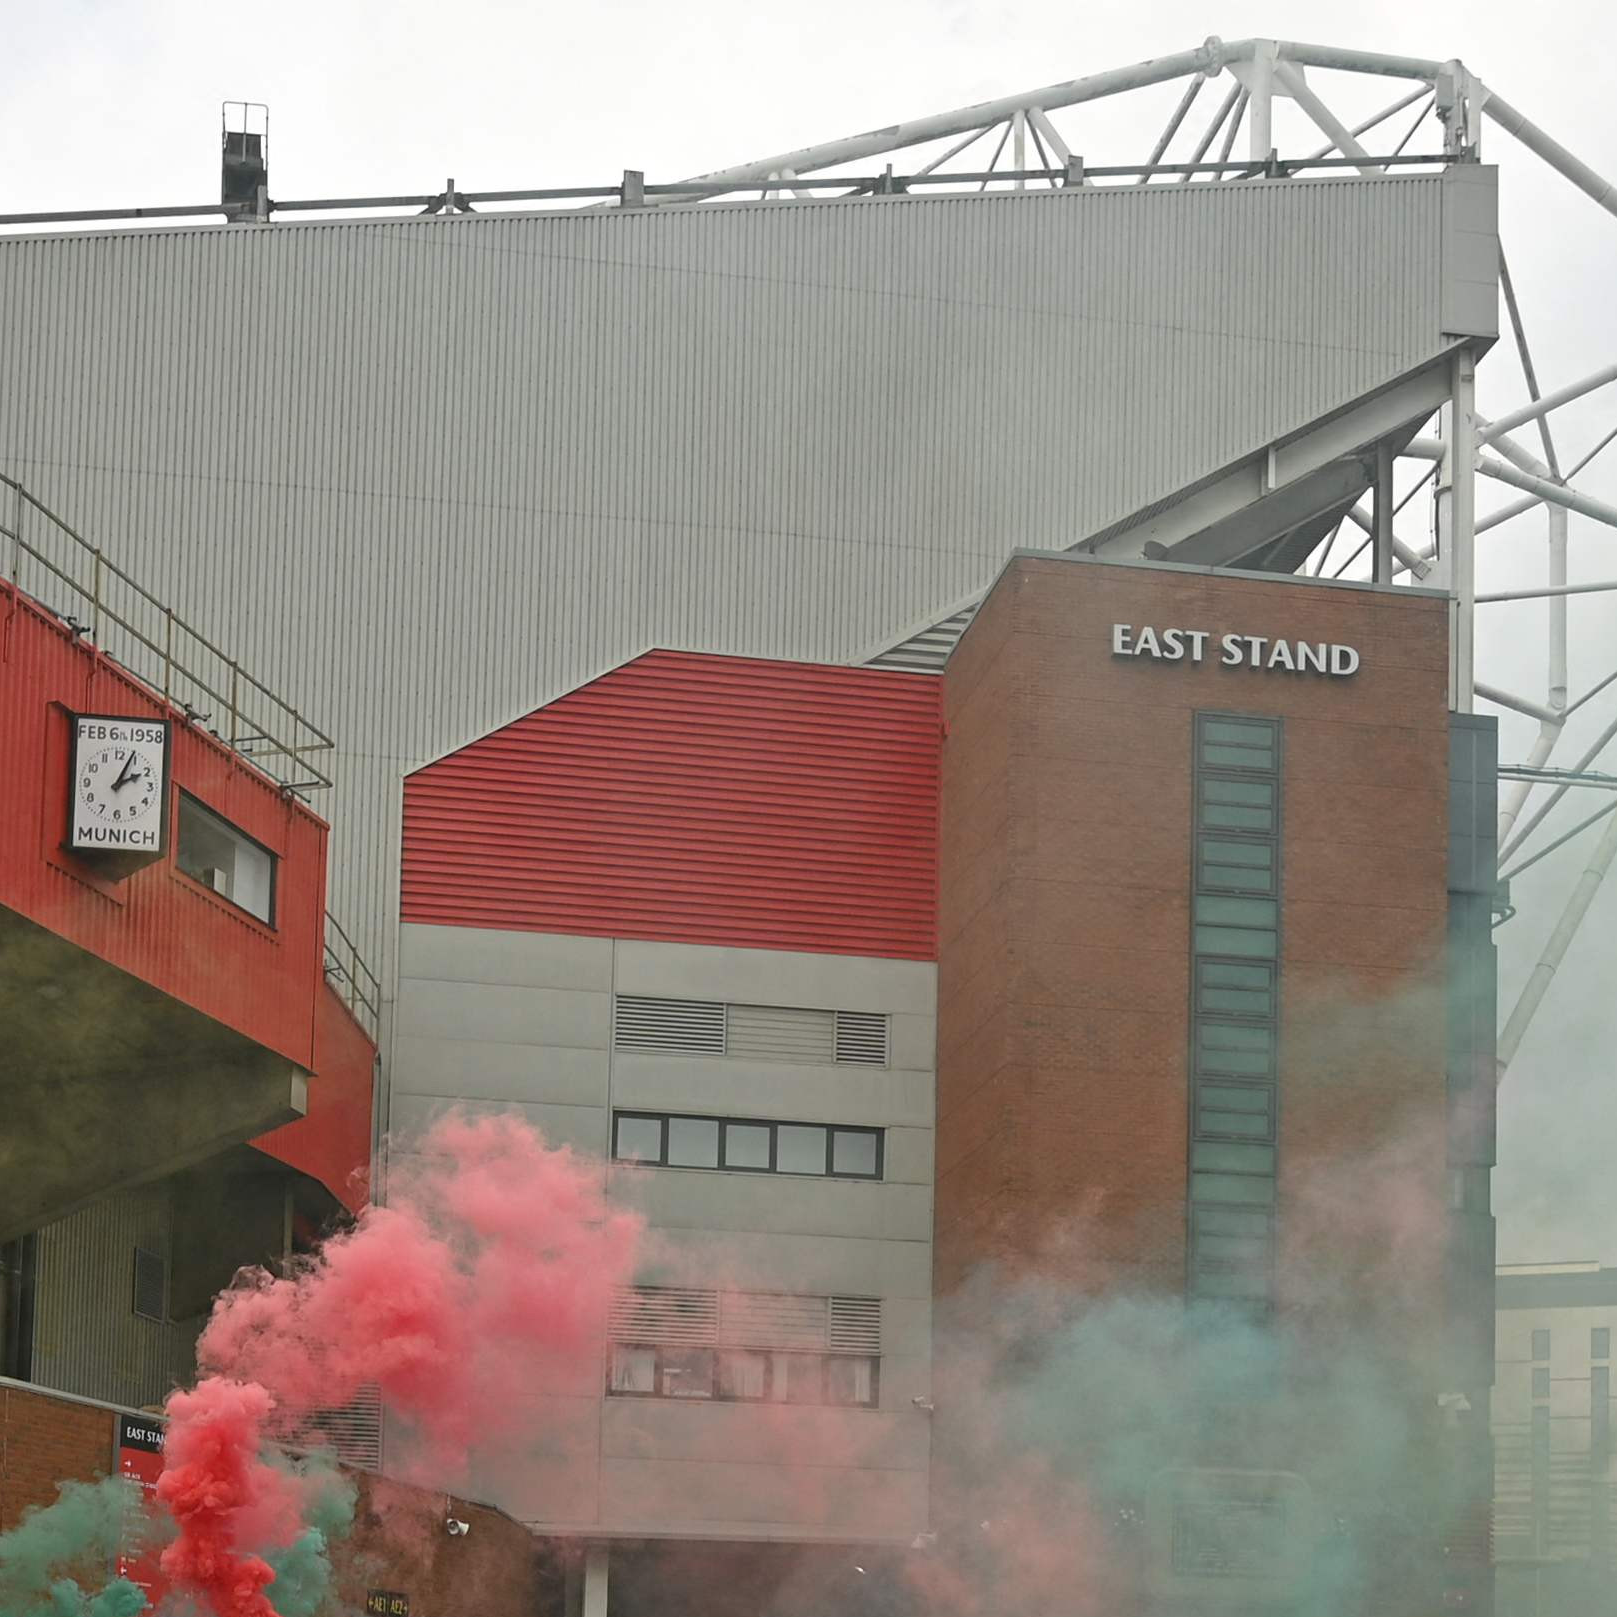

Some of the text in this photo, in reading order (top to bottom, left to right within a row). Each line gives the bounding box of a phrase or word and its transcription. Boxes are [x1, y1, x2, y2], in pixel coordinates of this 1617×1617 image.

[1112, 623, 1360, 676] EAST STAND
[78, 724, 107, 740] FEB
[129, 727, 163, 744] 1958
[101, 753, 109, 764] 11
[114, 750, 126, 761] 12
[132, 754, 138, 766] 1
[88, 763, 99, 774] 10
[143, 767, 151, 778] 2
[83, 777, 91, 788] 9
[146, 782, 155, 793] 3
[86, 792, 95, 803] 8
[141, 797, 149, 807] 4
[98, 803, 106, 814] 7
[129, 806, 137, 816] 5
[113, 809, 121, 820] 6
[78, 826, 155, 845] MUNICH
[126, 1425, 146, 1441] EAST
